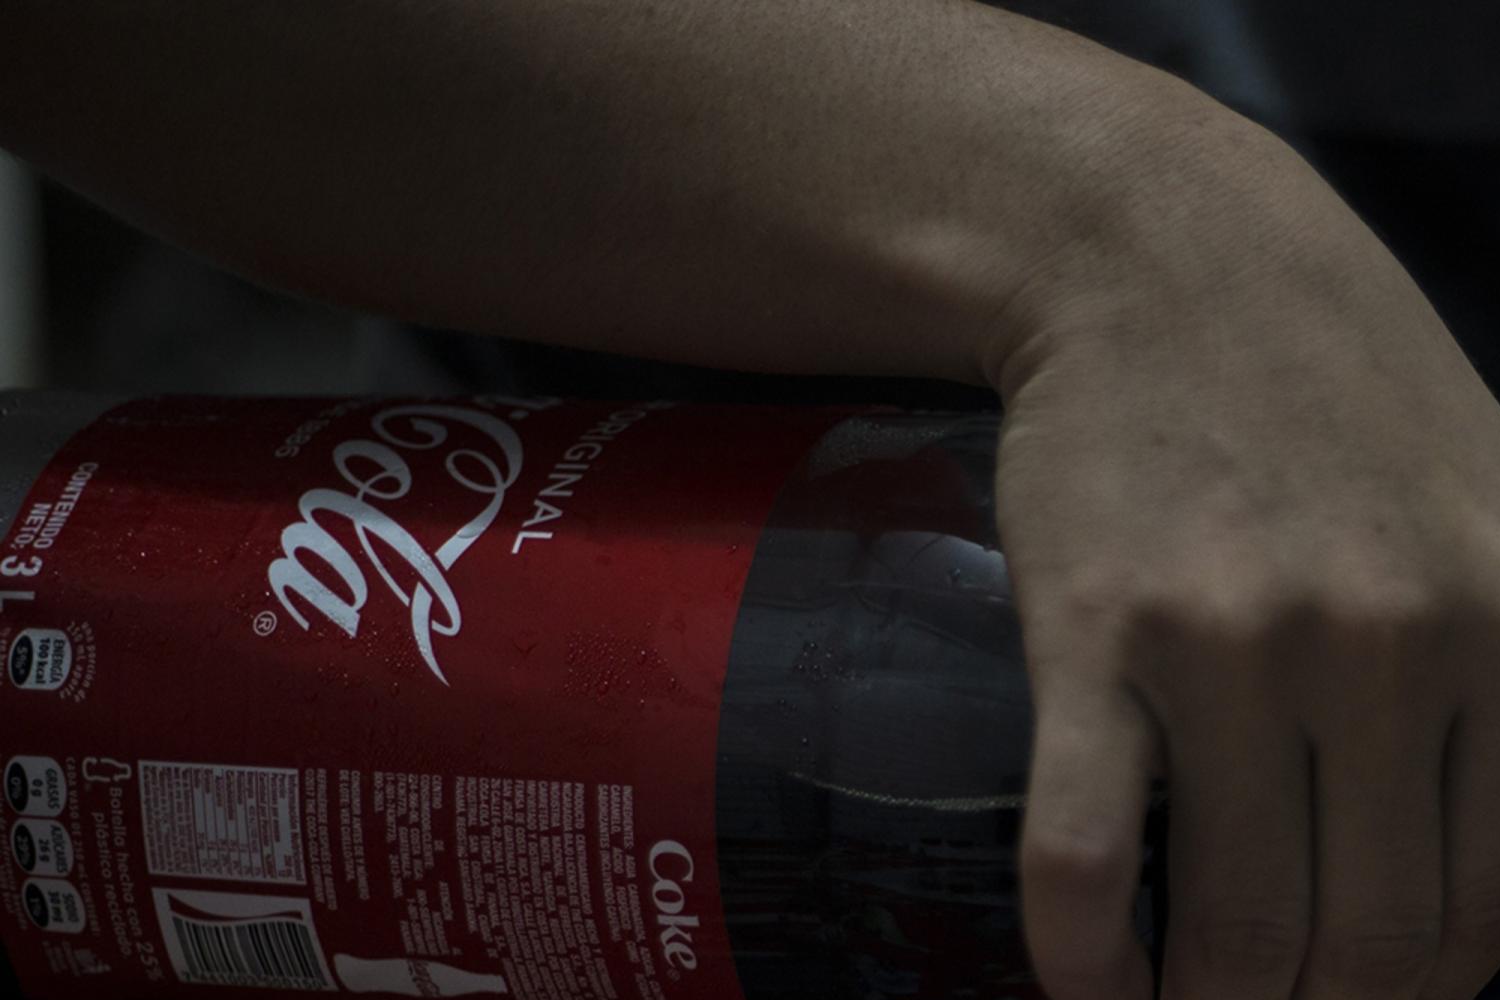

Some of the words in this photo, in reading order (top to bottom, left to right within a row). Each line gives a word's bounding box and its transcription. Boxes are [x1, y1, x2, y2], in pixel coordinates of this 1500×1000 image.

[512, 410, 648, 554] ORIGINAL
[32, 462, 100, 549] CONTENIDO
[10, 503, 52, 550] NETO:
[0, 555, 44, 577] 3
[37, 638, 51, 659] 100
[50, 639, 66, 683] ENERGÍA
[35, 661, 49, 684] kcal
[82, 645, 97, 688] porción
[73, 689, 86, 703] de
[31, 779, 43, 787] 0
[66, 756, 77, 786] CADA
[339, 769, 350, 781] DE
[30, 789, 42, 798] g
[46, 768, 61, 809] GRASAS
[316, 768, 329, 825] REFRIGÉRESE
[339, 783, 350, 807] LOTE:
[351, 770, 361, 816] CONSUMIR
[432, 775, 442, 809] CENTRO
[467, 776, 479, 828] INDUSTRIAL
[479, 777, 491, 827] COCA-COLA
[503, 778, 514, 797] SAN
[515, 780, 526, 810] FEMSA
[69, 790, 80, 820] VASO
[109, 786, 128, 848] Botella
[305, 798, 317, 815] THE
[340, 808, 351, 826] VER
[491, 790, 503, 816] CALLE
[527, 780, 538, 830] IMPORTADO
[538, 781, 550, 832] CARRETERA
[550, 781, 561, 828] INDUSTRIA
[562, 782, 574, 832] NICARAGUA
[574, 782, 585, 830] PRODUCTO
[598, 783, 610, 849] SABORIZANTES
[623, 785, 634, 849] INGREDIENTES:
[72, 822, 82, 836] DE
[352, 817, 363, 844] ANTES
[515, 812, 526, 825] DE
[38, 838, 50, 853] 26
[51, 825, 69, 873] AZÚCARES
[307, 816, 321, 863] COCA-COLA
[319, 826, 333, 863] DESPUÉS
[354, 845, 364, 857] DE
[410, 828, 422, 856] COSTA
[434, 840, 445, 851] DE
[468, 835, 480, 854] SAN
[480, 835, 493, 865] FEMSA
[493, 840, 505, 864] ZONA
[505, 824, 518, 875] GUATEMALA
[515, 826, 528, 855] COSTA
[563, 833, 575, 857] BAJO
[39, 854, 50, 863] g
[322, 864, 333, 876] DE
[528, 841, 543, 895] DISTRIBUIDO
[552, 835, 566, 876] NACIONAL
[625, 855, 637, 879] AGUA
[91, 811, 114, 880] plástico
[104, 883, 133, 960] reciclado.
[116, 852, 135, 905] hecha
[310, 864, 325, 904] COMPANY
[355, 866, 371, 901] NÚMERO
[484, 872, 496, 884] DE
[509, 877, 521, 893] POR
[565, 857, 580, 894] LICENCIA
[575, 834, 593, 915] CENTROAMERICANO
[600, 850, 618, 905] (INCLUYENDO
[439, 880, 454, 921] ATENCIÓN
[497, 877, 511, 908] CIUDAD
[533, 896, 545, 909] EN
[556, 885, 568, 897] DE
[569, 895, 581, 907] DE
[612, 847, 625, 874] ÁCIDO
[625, 941, 640, 963] COMO
[648, 839, 700, 970] Coke
[62, 894, 80, 923] SODIO
[129, 907, 144, 938] con
[501, 908, 512, 920] DE
[522, 903, 538, 928] CALLE
[536, 909, 550, 935] COSTA
[478, 914, 494, 944] CIUDAD
[558, 904, 579, 948] REFRESCOS
[585, 919, 601, 945] HECHO
[541, 936, 556, 955] RICA
[574, 923, 593, 965] COCA-COLA
[135, 941, 167, 983] 25%
